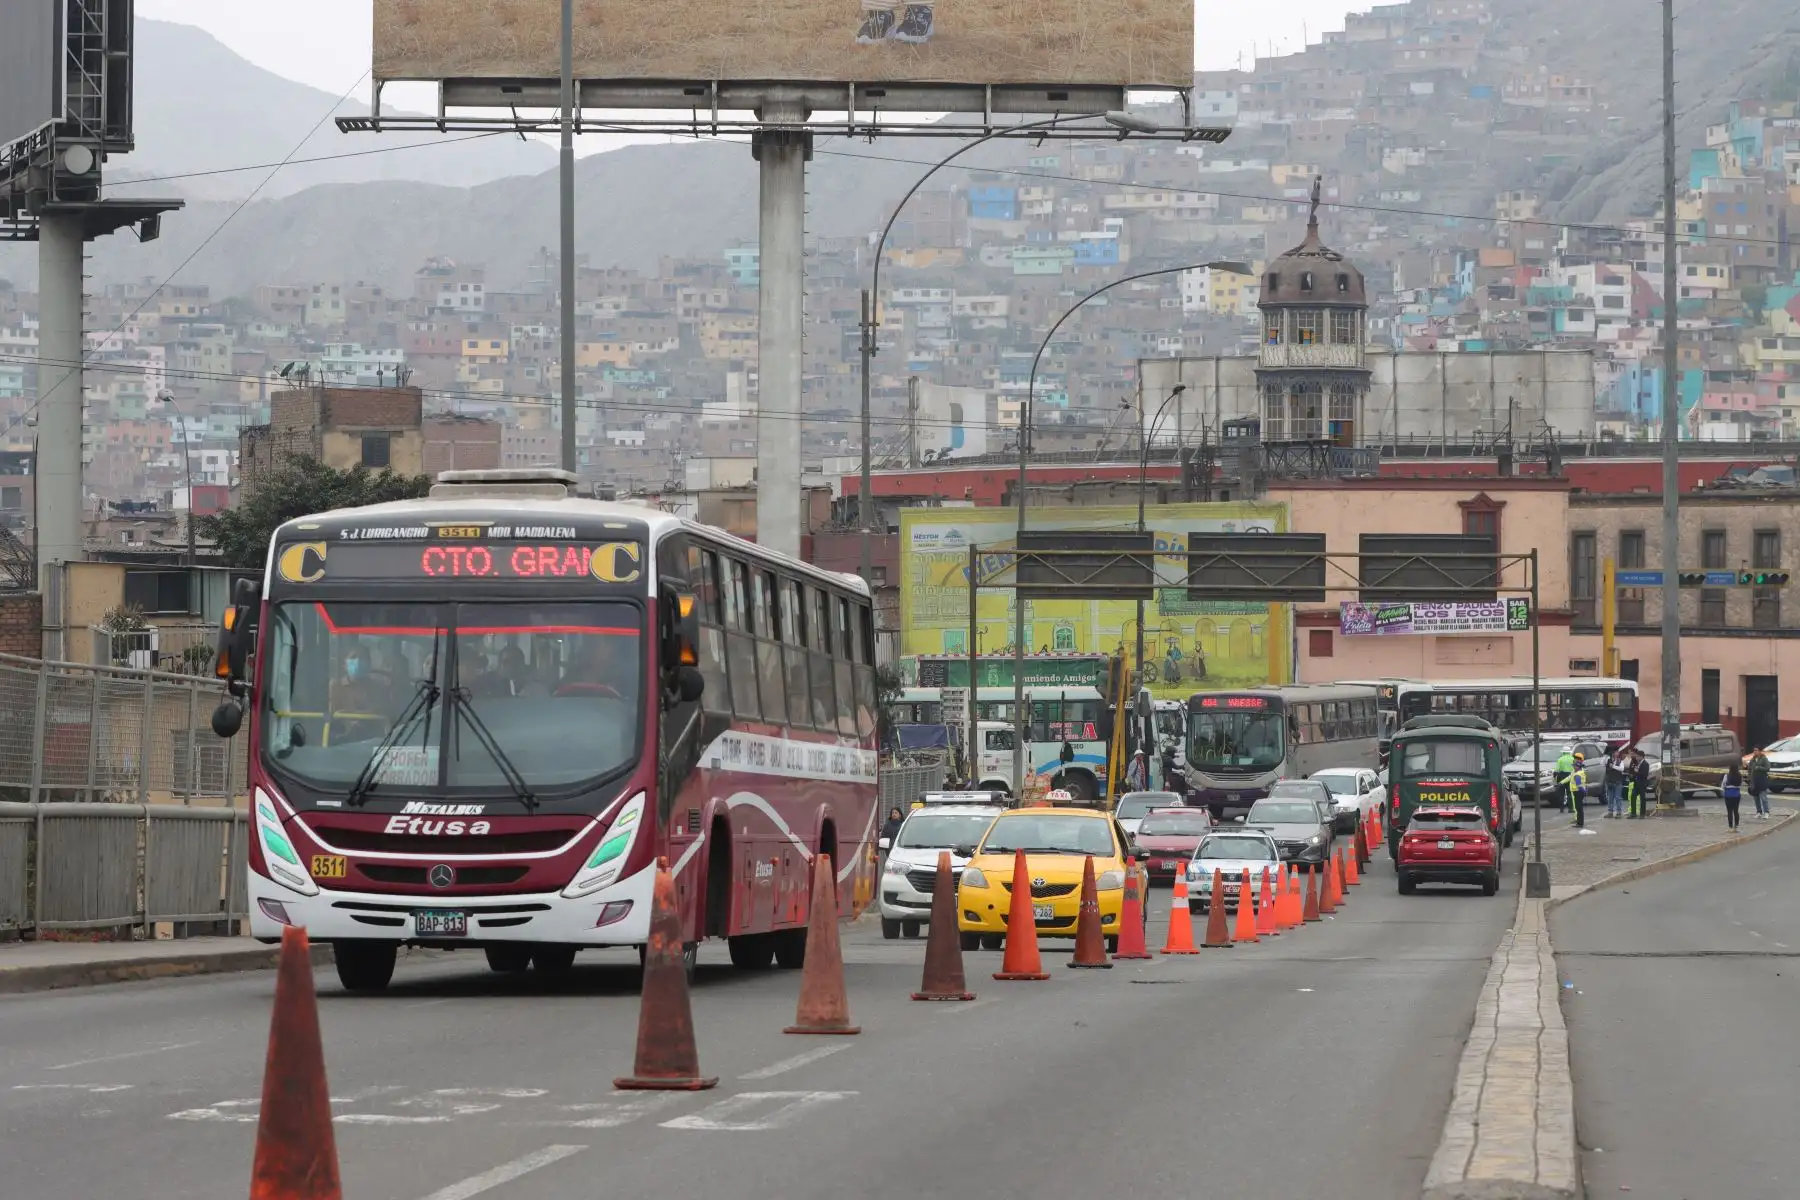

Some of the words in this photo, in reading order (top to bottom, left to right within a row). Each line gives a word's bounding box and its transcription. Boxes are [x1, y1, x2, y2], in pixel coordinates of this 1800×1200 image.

[360, 527, 429, 539] LURIGANCHO
[441, 528, 478, 537] 3511
[279, 541, 327, 583] C
[421, 546, 500, 577] CTO.
[589, 541, 640, 583] C
[1413, 602, 1453, 611] RENZO
[1456, 600, 1505, 610] PADILLA
[1413, 610, 1449, 619] LOS
[1455, 609, 1505, 618] ECOS
[1510, 606, 1528, 618] 12
[1063, 673, 1097, 684] Amigos
[1419, 791, 1471, 801] POLICÍA
[384, 815, 491, 835] Etusa
[313, 857, 345, 876] 3511
[418, 916, 464, 931] BAP-813
